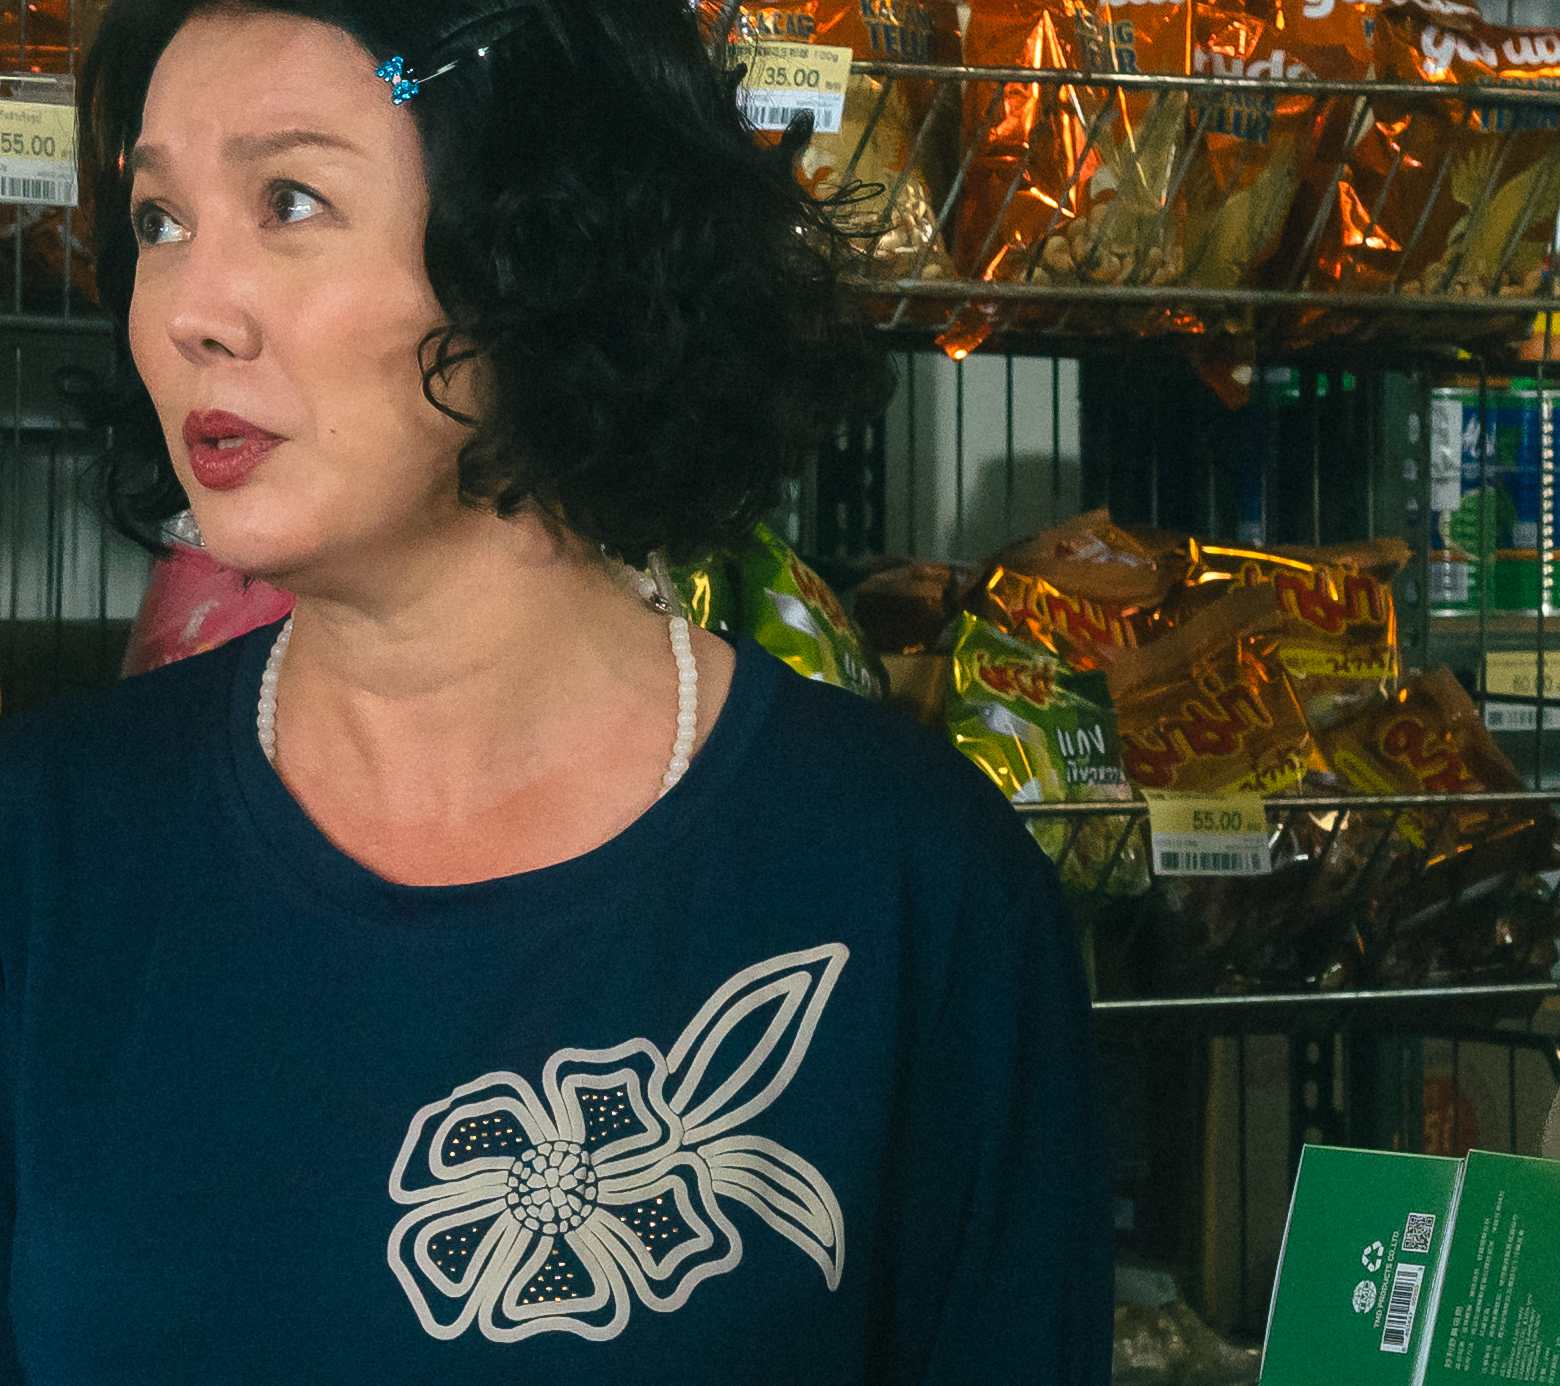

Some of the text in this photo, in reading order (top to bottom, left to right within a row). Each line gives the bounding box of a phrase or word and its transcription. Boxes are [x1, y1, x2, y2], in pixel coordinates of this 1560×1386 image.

[1, 132, 56, 157] 55.00
[1192, 810, 1242, 831] 55.00
[1378, 1263, 1393, 1309] PRODUCTS
